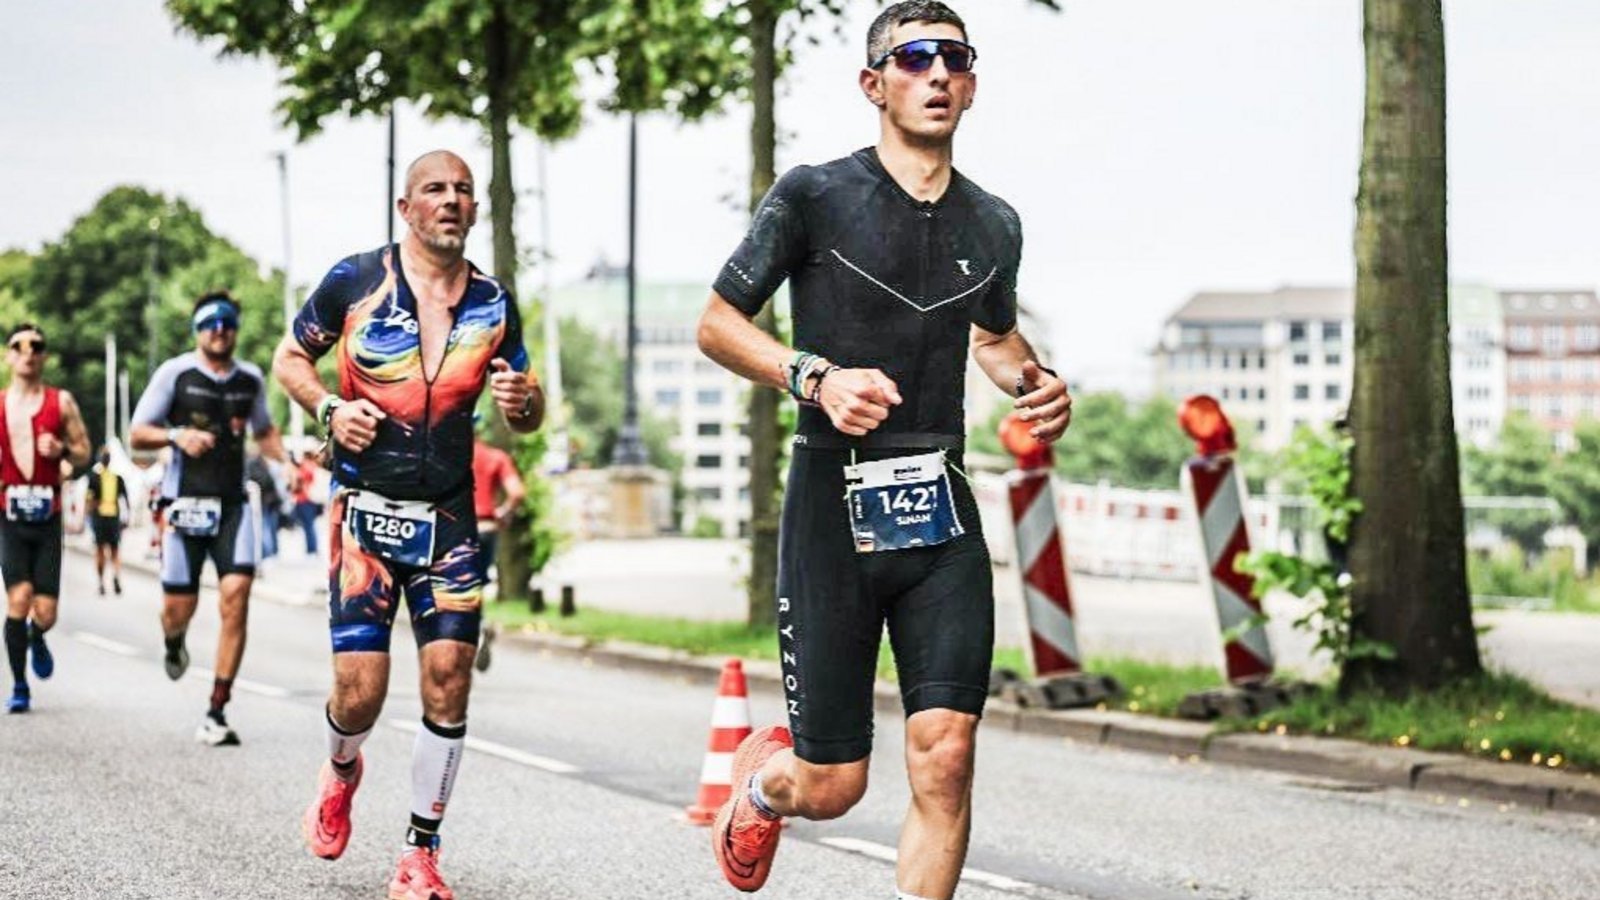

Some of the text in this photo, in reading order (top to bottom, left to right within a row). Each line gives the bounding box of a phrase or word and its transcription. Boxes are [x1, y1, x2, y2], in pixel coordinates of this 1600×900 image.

[878, 485, 938, 514] 1421
[365, 514, 417, 540] 1280
[896, 513, 932, 526] SINAN
[778, 597, 800, 716] RYZON
